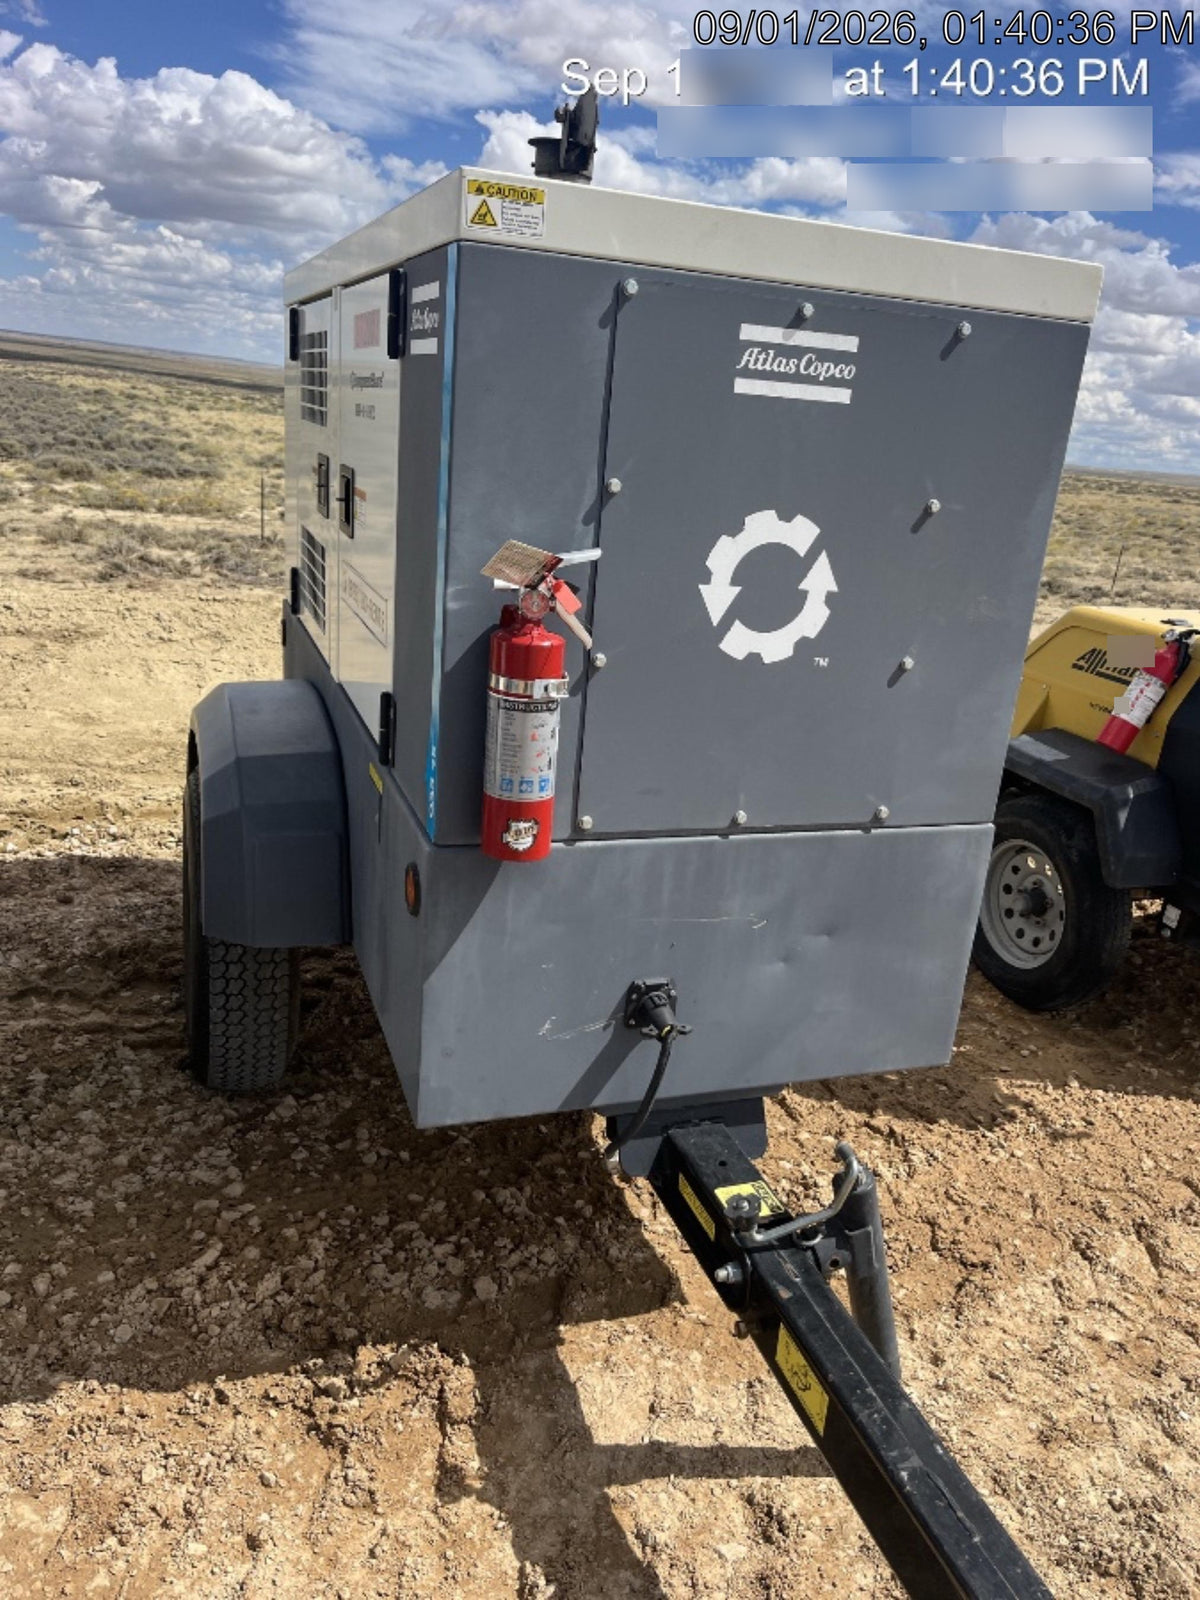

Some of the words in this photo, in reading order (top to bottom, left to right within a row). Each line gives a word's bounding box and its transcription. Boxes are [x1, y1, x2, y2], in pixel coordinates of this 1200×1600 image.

[486, 184, 537, 202] CAUTION
[736, 347, 799, 374] Atlas
[800, 353, 857, 381] Copco
